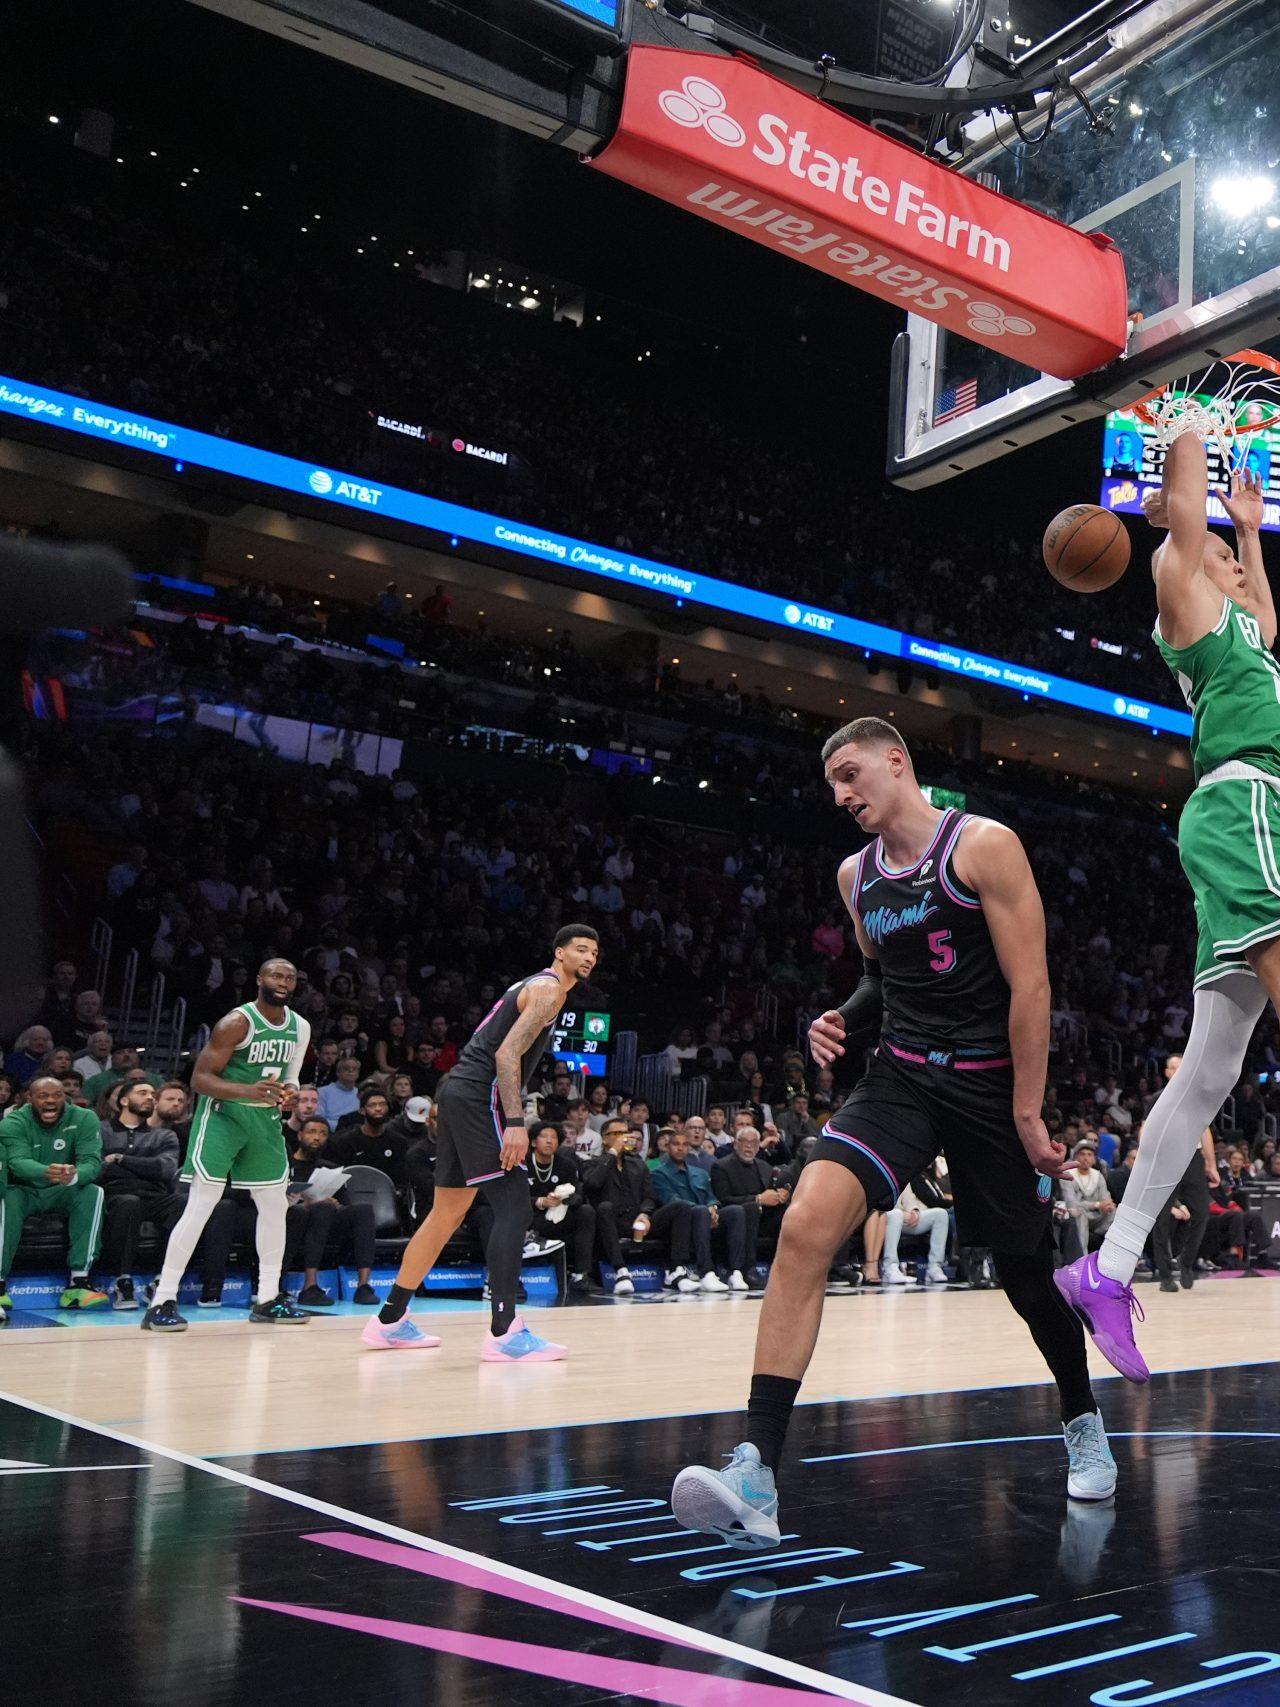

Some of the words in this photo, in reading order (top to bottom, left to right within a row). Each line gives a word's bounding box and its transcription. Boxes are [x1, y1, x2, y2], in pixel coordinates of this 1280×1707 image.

[0, 386, 63, 416] hanges
[336, 482, 382, 504] AT&T
[495, 527, 566, 558] Connecting
[571, 547, 624, 572] Changes
[803, 613, 834, 630] AT&T
[911, 643, 960, 667] Connecting
[863, 890, 941, 945] Miami
[927, 929, 957, 974] 5
[583, 1040, 597, 1053] 30
[428, 1271, 483, 1282] ticketmaster
